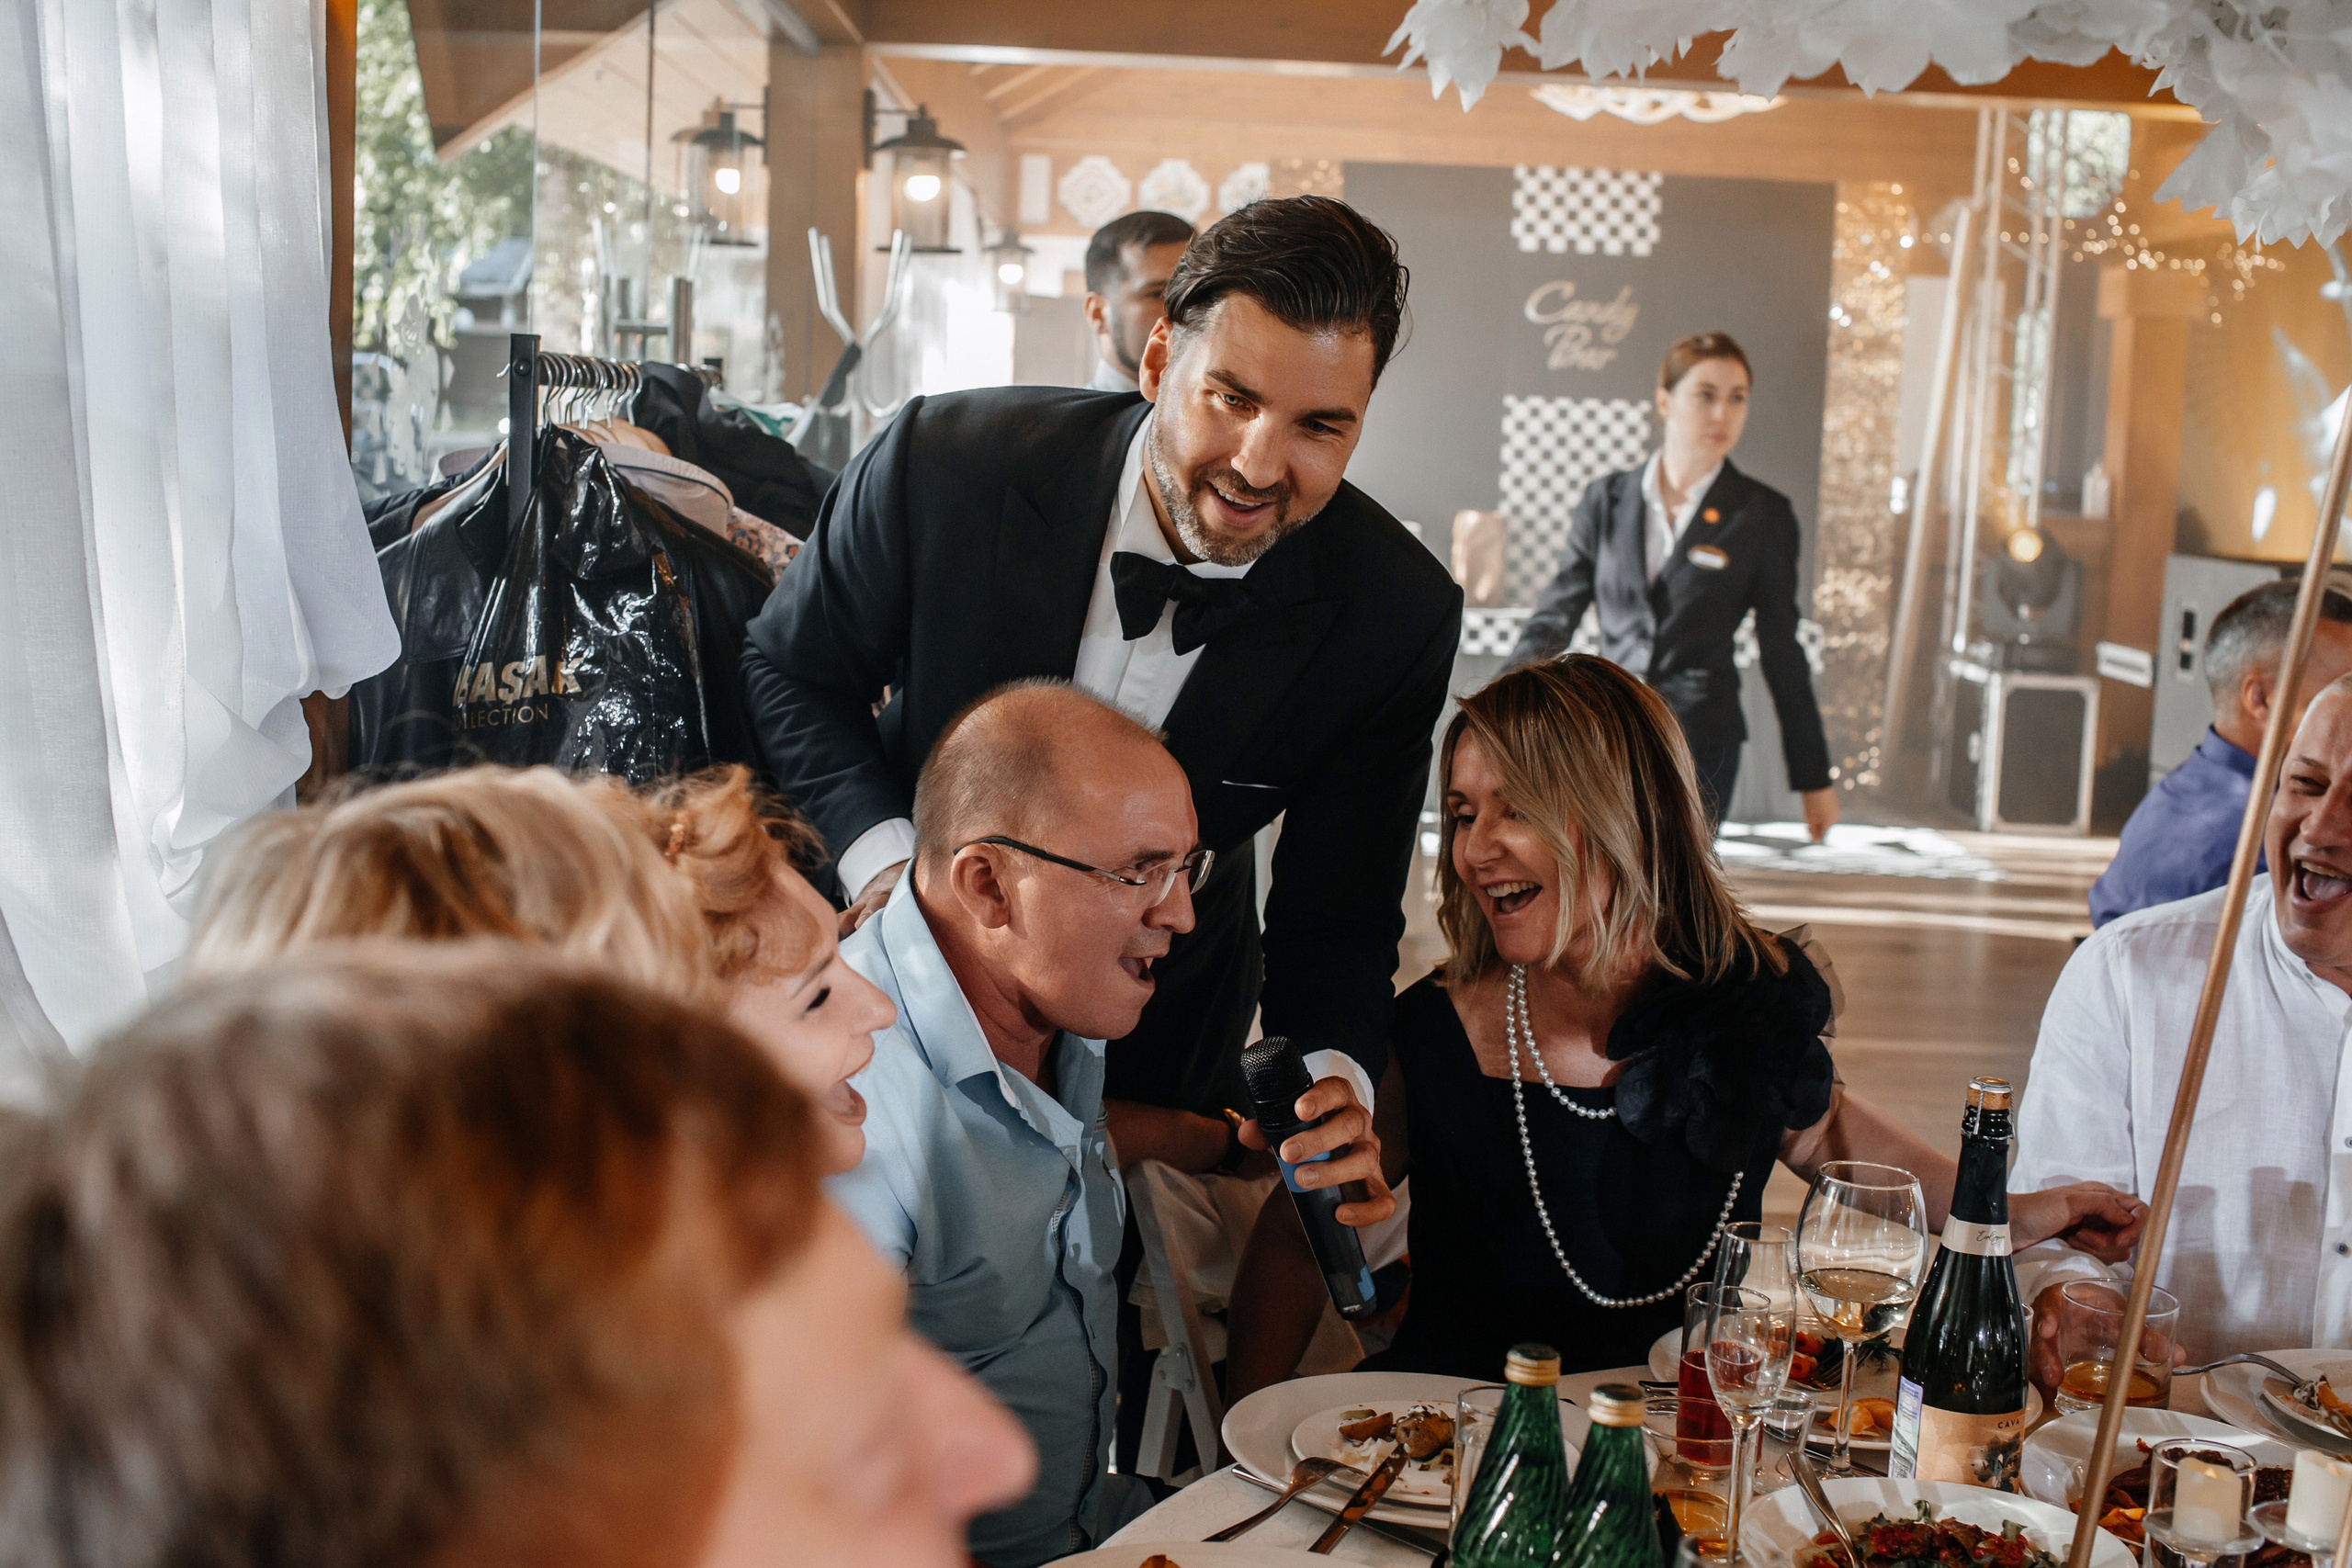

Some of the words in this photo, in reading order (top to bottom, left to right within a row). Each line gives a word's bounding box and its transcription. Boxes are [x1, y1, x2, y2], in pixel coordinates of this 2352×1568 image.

[1524, 280, 1640, 344] Candy
[1544, 323, 1618, 370] Bar
[454, 703, 548, 732] OLLECTION
[1997, 1418, 2019, 1429] CAVA
